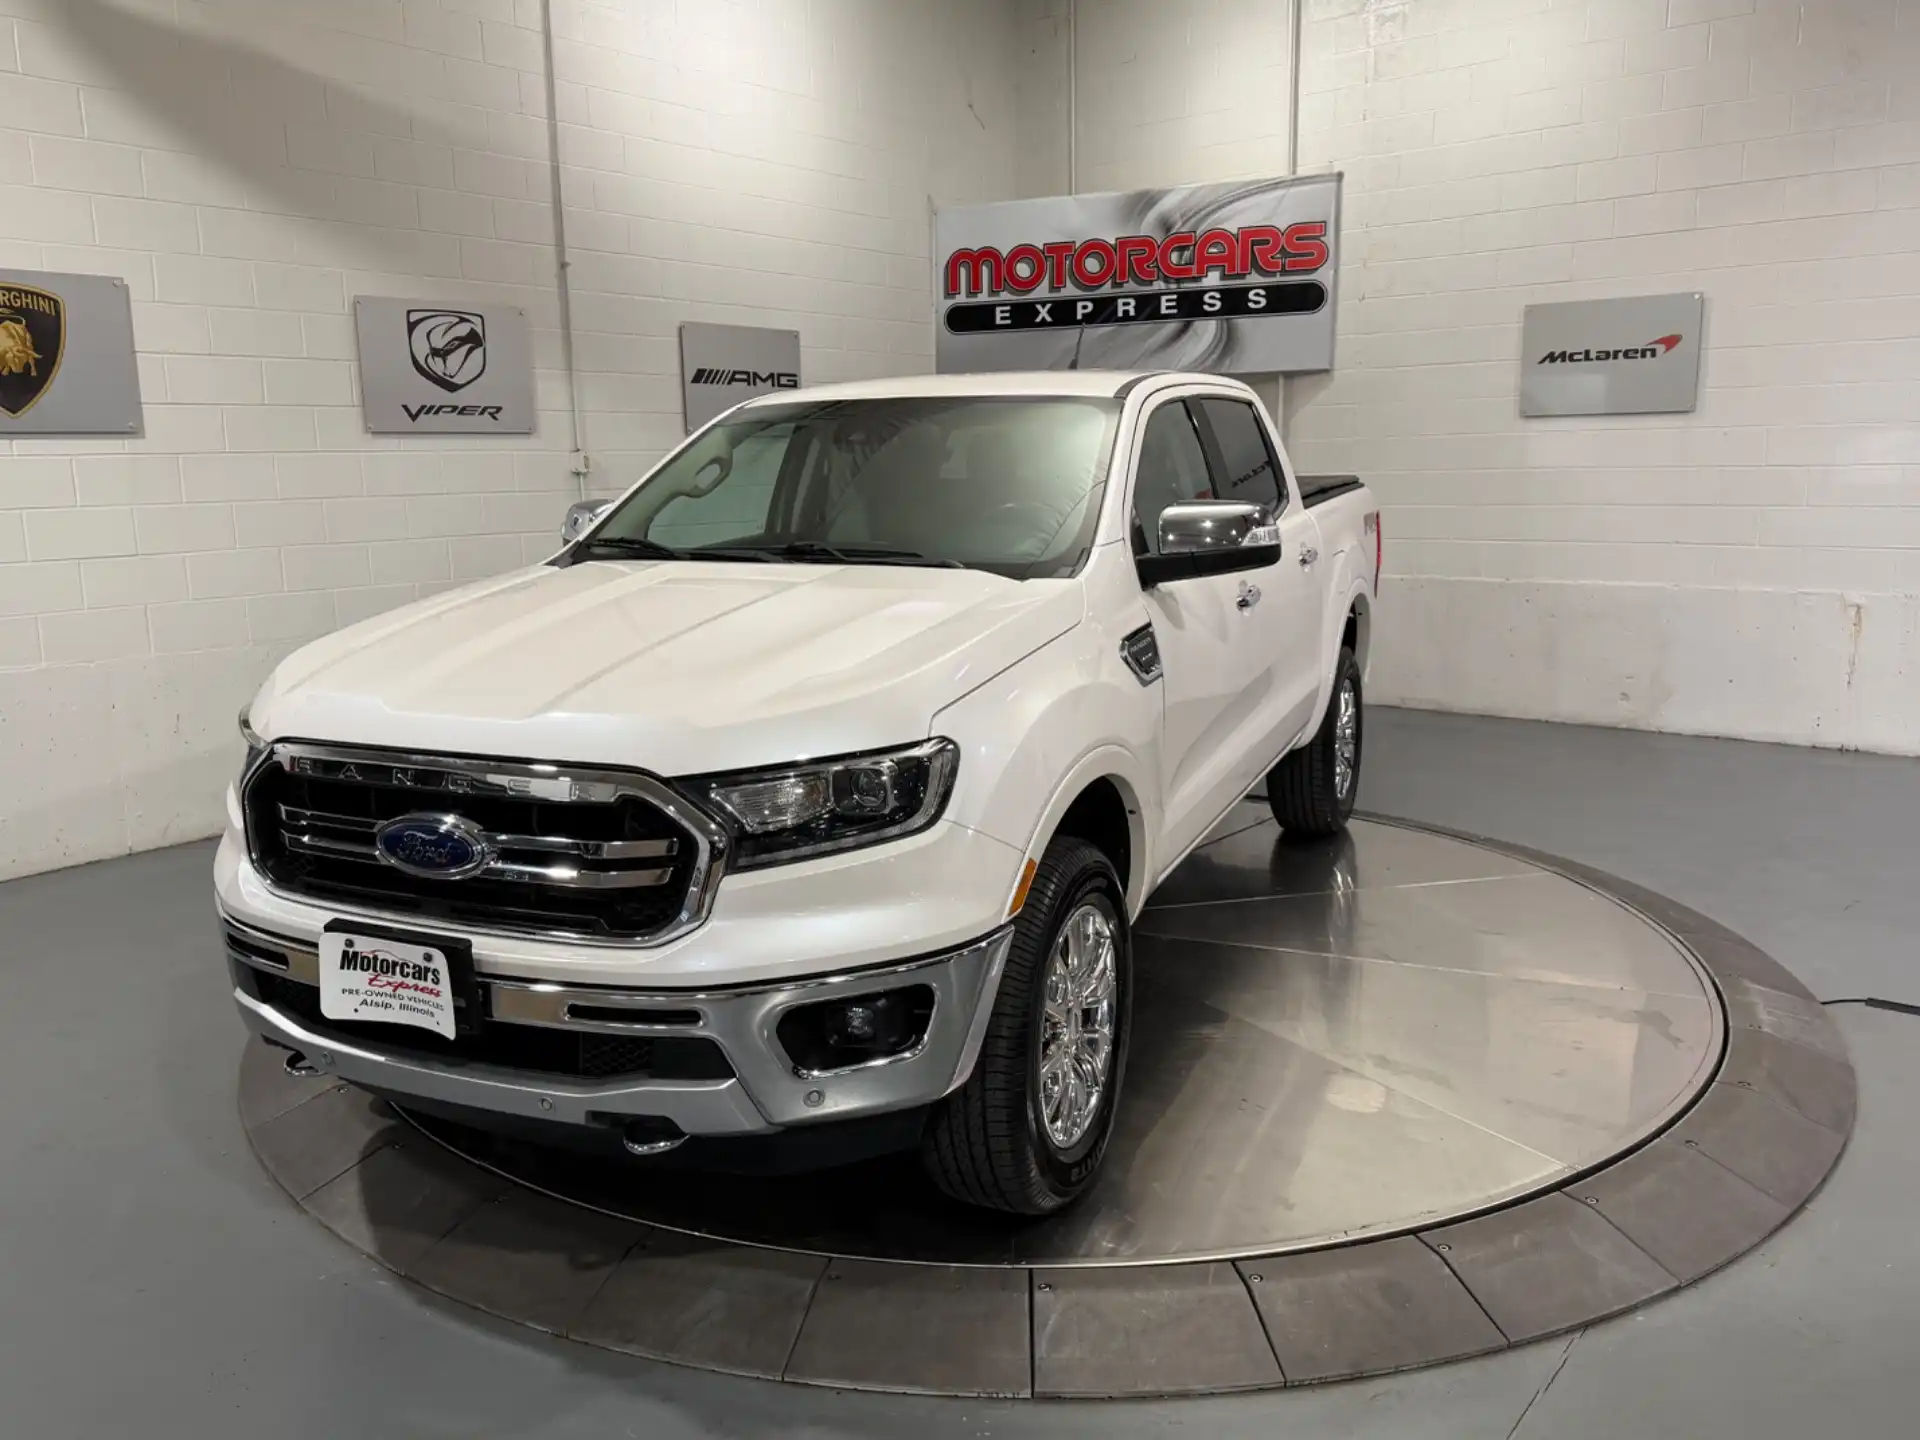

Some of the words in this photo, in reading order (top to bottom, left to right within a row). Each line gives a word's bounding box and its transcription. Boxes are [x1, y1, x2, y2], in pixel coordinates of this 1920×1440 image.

[944, 221, 1329, 298] MOTORCARS
[995, 288, 1267, 325] EXPRESS
[1537, 347, 1657, 365] McLaren
[401, 404, 503, 424] VIPER
[339, 949, 441, 986] Motorcars
[368, 973, 443, 998] Express
[342, 987, 405, 1001] PRE-OWNED
[406, 995, 445, 1012] VEHICLES
[399, 1002, 436, 1018] Illinois
